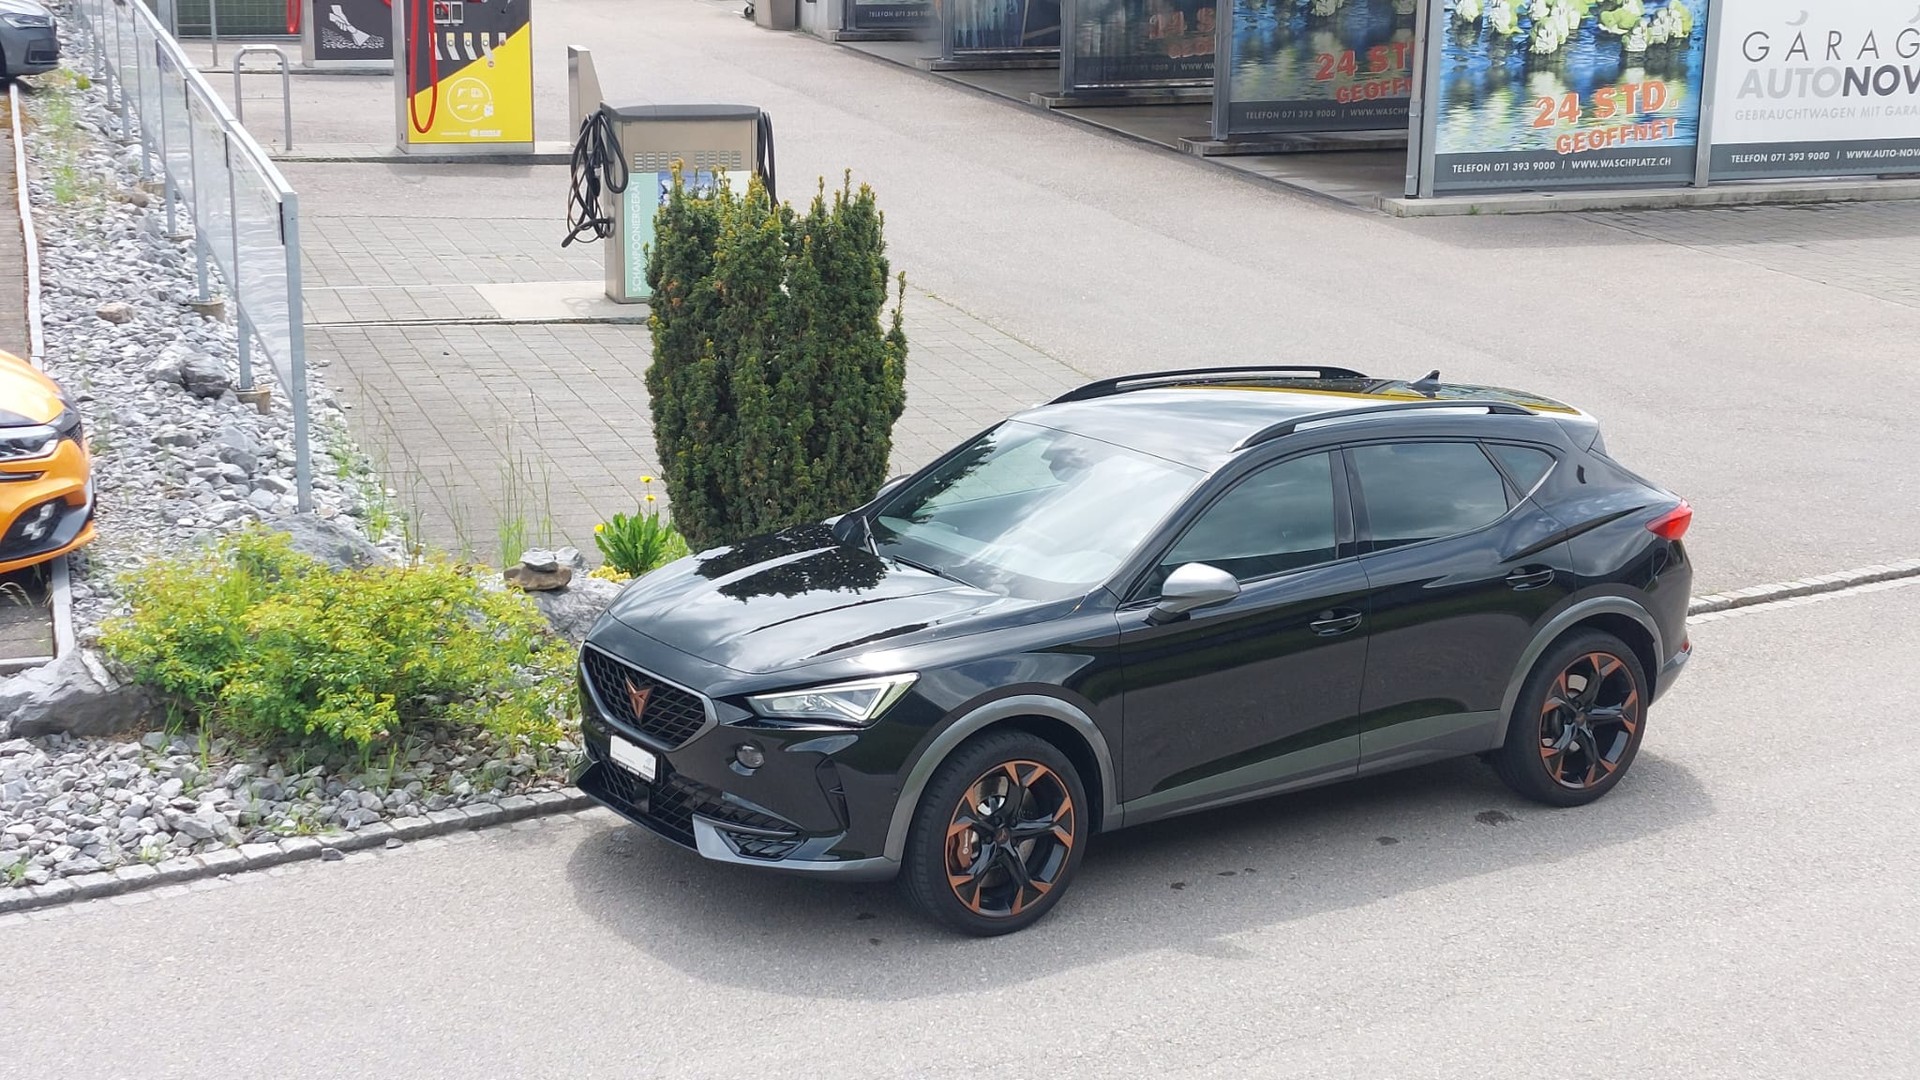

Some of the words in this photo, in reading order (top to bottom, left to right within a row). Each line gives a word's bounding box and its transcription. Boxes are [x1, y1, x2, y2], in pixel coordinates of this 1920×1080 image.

[1315, 48, 1358, 82] 24
[1533, 91, 1582, 130] 24
[1594, 79, 1679, 121] STD.
[1246, 111, 1279, 120] TELEFON
[1282, 111, 1296, 119] 071
[1299, 110, 1313, 119] 393
[1316, 110, 1336, 118] 9000
[1735, 106, 1856, 121] GEBRAUCHTWAGEN
[1860, 106, 1881, 118] MIT
[1452, 163, 1491, 174] TELEFON
[1493, 162, 1509, 172] 071
[1512, 162, 1530, 172] 393
[1532, 160, 1556, 171] 9000
[1571, 157, 1672, 170] WWW.WASCHPLATZ.CH
[1731, 153, 1768, 164] TELEFON
[1770, 153, 1786, 162] 071
[1788, 152, 1805, 162] 393
[1807, 151, 1830, 161] 9000
